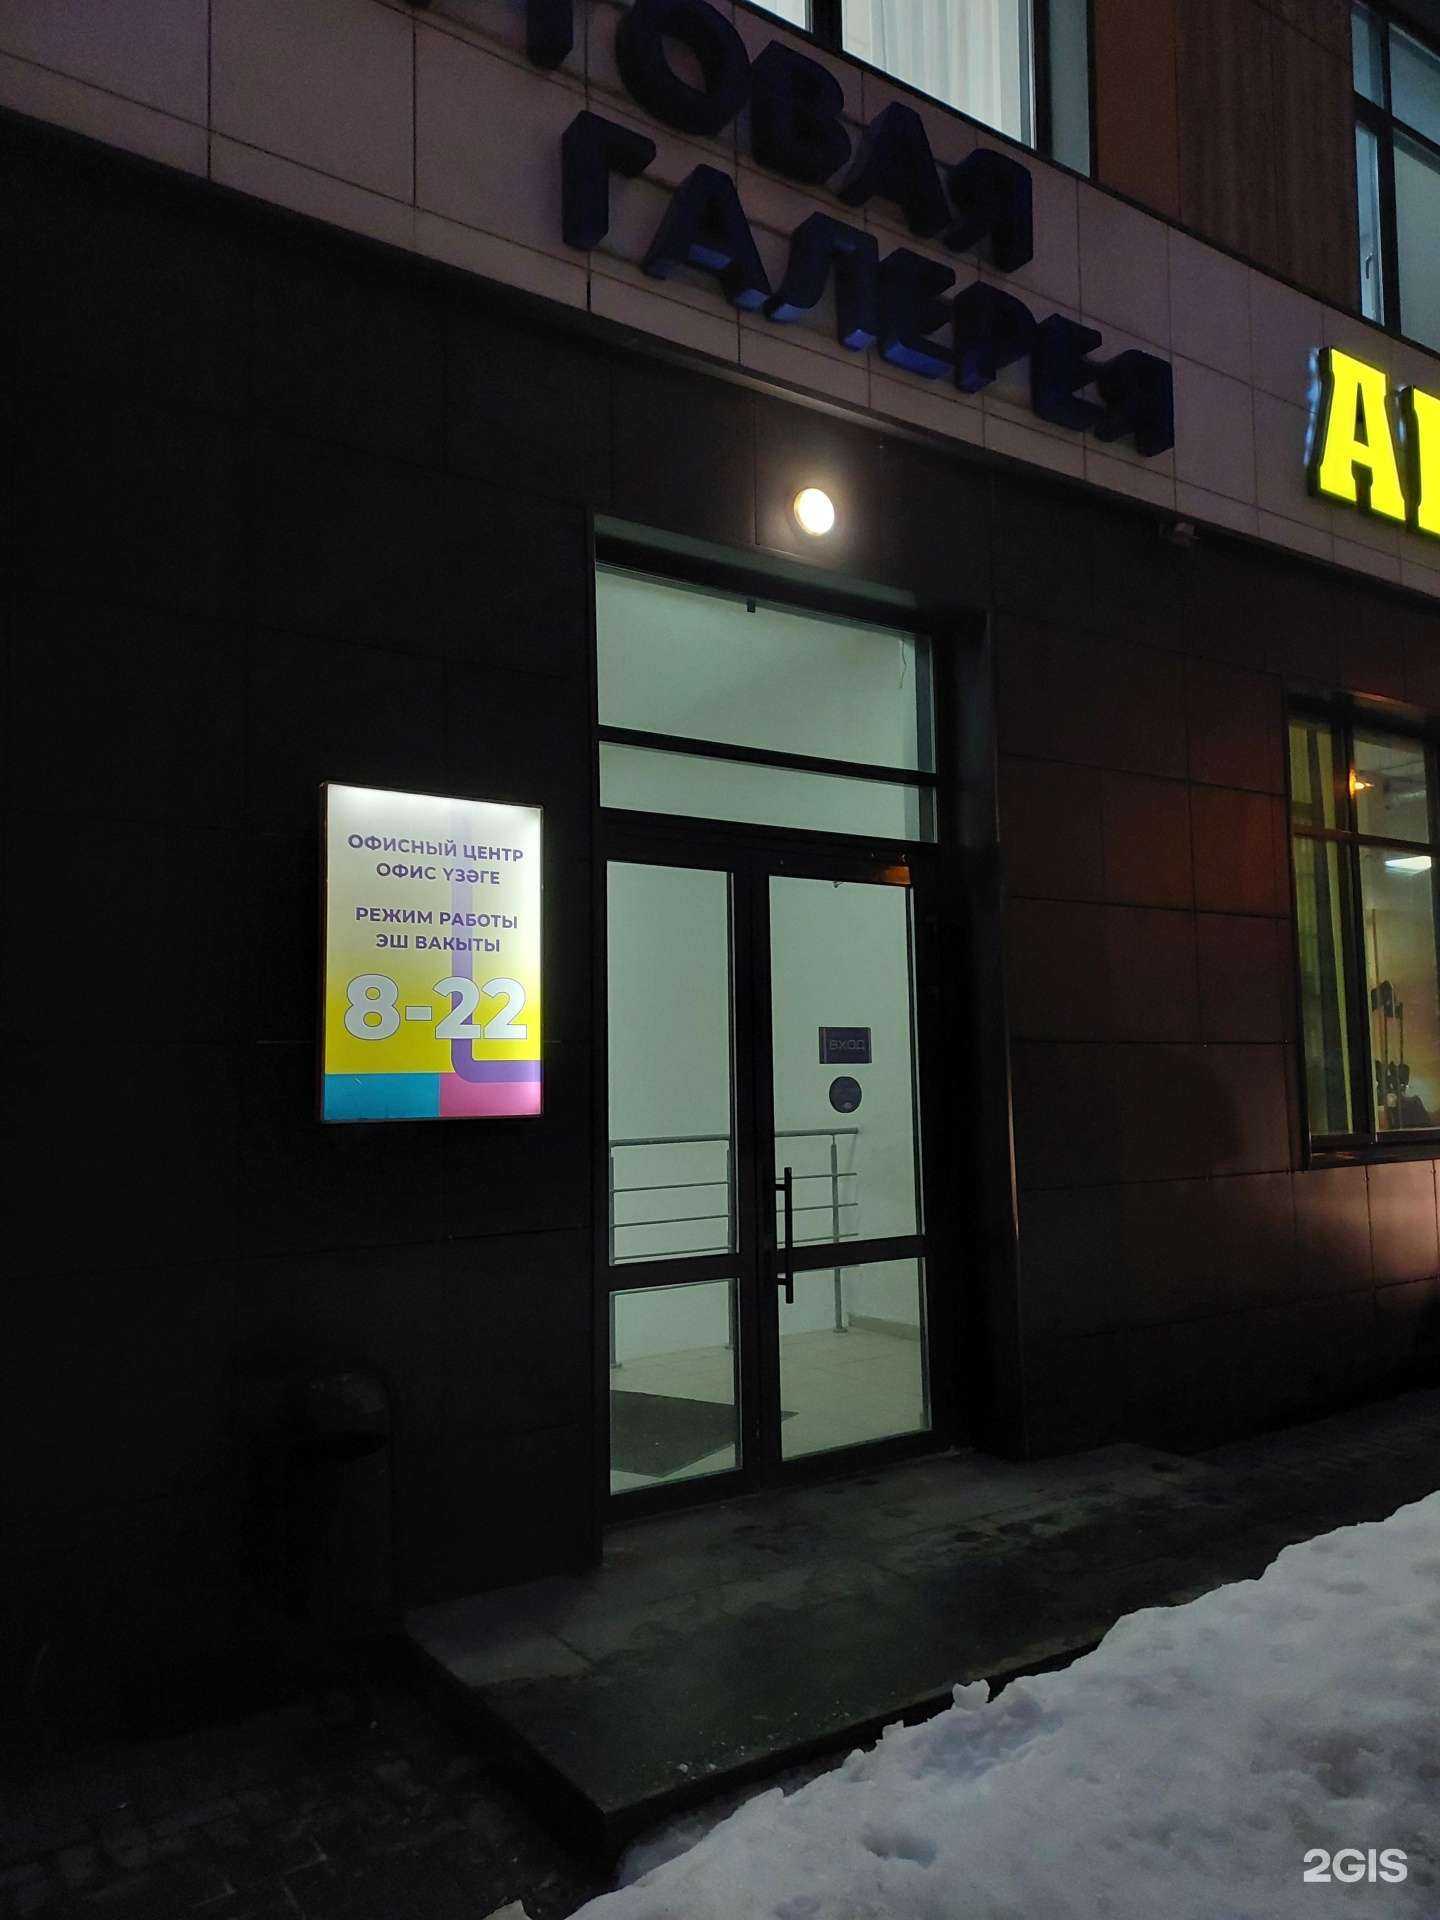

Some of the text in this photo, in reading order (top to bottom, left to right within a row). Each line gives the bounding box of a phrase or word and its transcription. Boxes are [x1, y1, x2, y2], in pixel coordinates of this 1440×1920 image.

[562, 110, 1175, 457] ГАЛЕРЕЯ
[348, 834, 523, 863] ОФИСНЫЙ ЦЕНТР
[376, 862, 437, 881] ОФИС
[355, 906, 518, 930] РЕЖИМ РАБОТЫ
[375, 933, 500, 953] ЭШ ВАКЫТЫ
[344, 973, 528, 1041] 8-22
